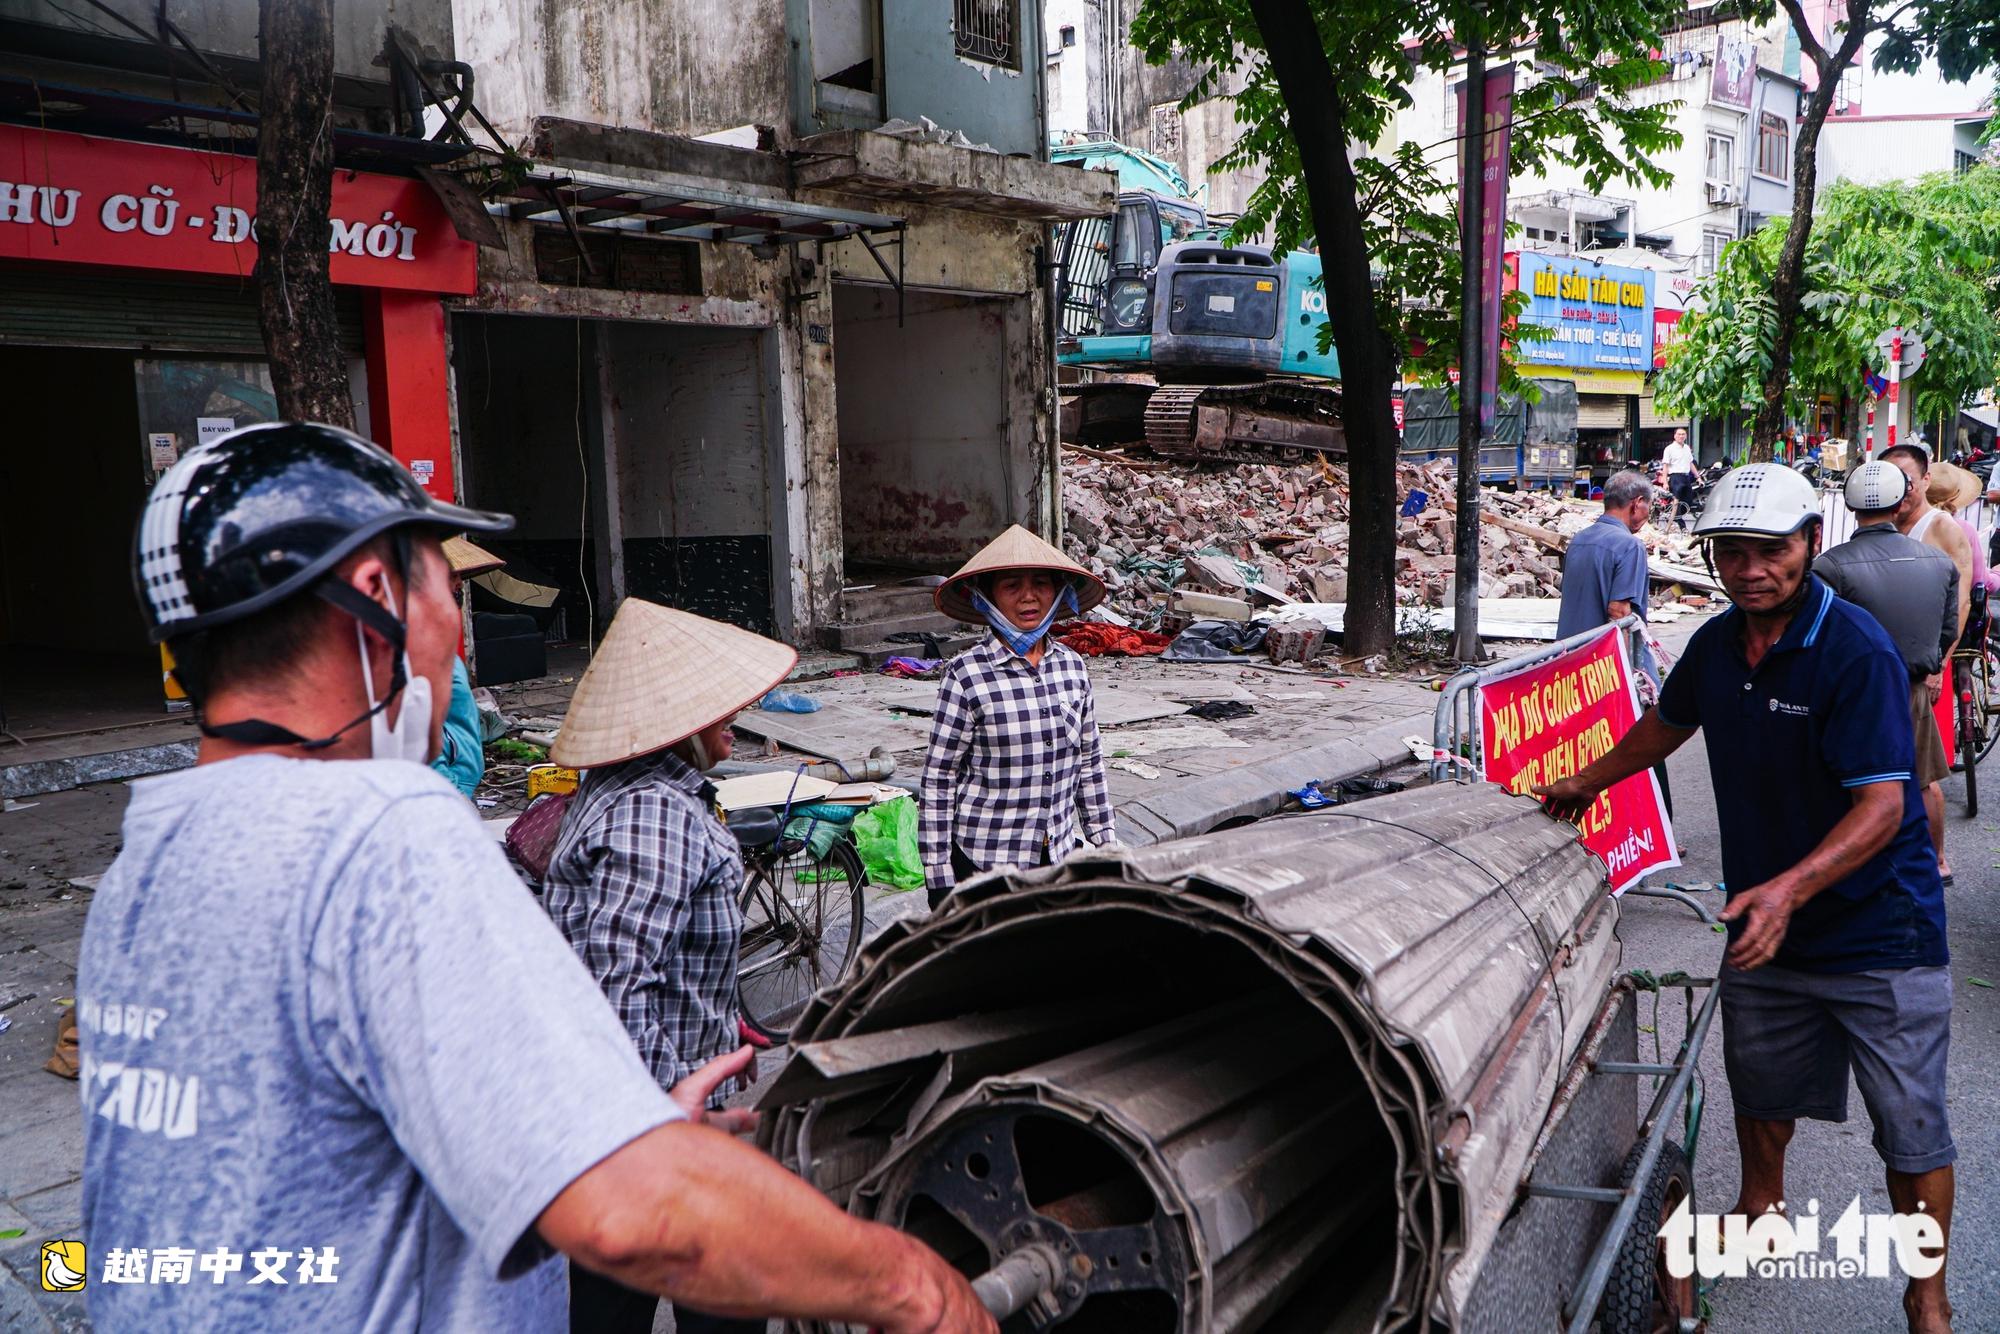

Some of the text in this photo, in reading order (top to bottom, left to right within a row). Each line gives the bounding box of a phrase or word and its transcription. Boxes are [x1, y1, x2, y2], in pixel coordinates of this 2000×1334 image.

[101, 184, 180, 236] CŨ
[329, 211, 418, 261] MỚI
[1620, 282, 1645, 308] CUA
[1493, 652, 1620, 760] PHÁ DỠ CÔNG TRÌNH
[1578, 717, 1615, 771] GPMB
